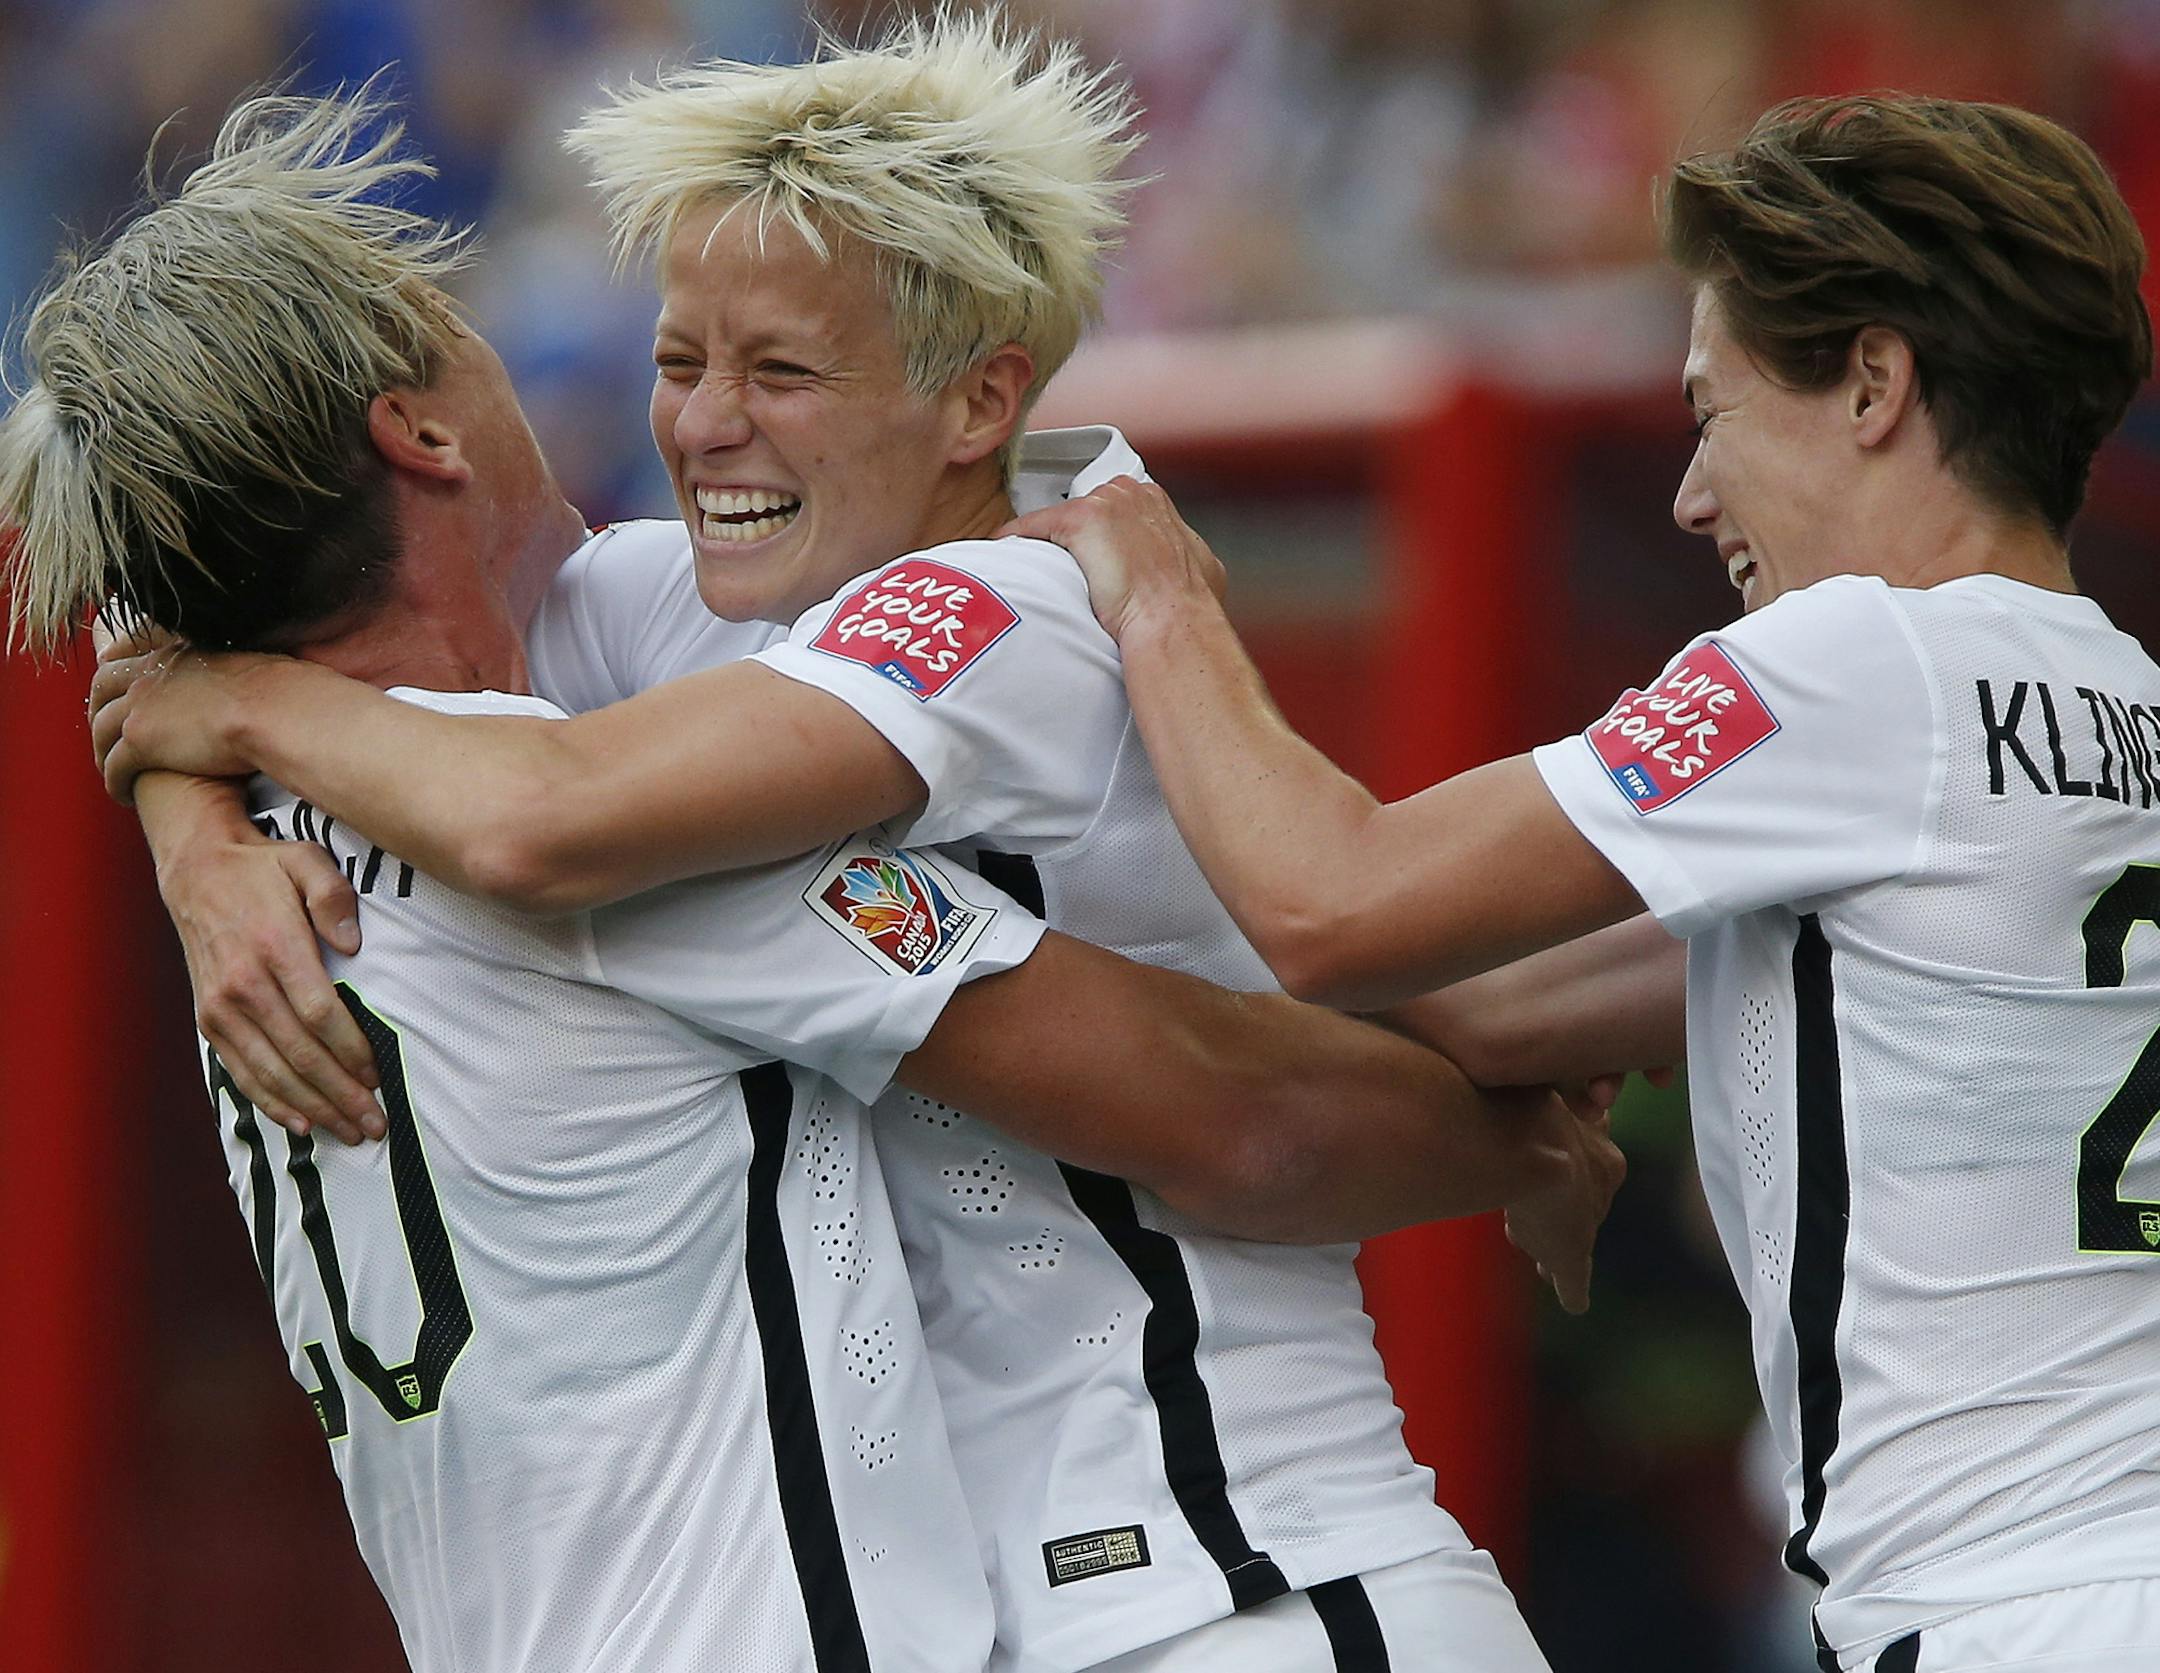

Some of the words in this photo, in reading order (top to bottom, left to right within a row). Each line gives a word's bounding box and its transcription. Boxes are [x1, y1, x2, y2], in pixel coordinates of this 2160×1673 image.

[881, 572, 975, 611] LIVE
[861, 591, 965, 648] YOUR
[837, 614, 959, 672] GOALS
[884, 664, 914, 688] FIFA
[1666, 667, 1738, 715] LIVE
[1603, 705, 1706, 778] GOALS
[1633, 694, 1720, 756] YOUR
[1976, 679, 2160, 810] KLING
[1623, 767, 1649, 796] FIFA
[941, 908, 967, 932] FIFA
[908, 933, 931, 966] 2015
[1055, 1541, 1104, 1558] AUTHENTIC
